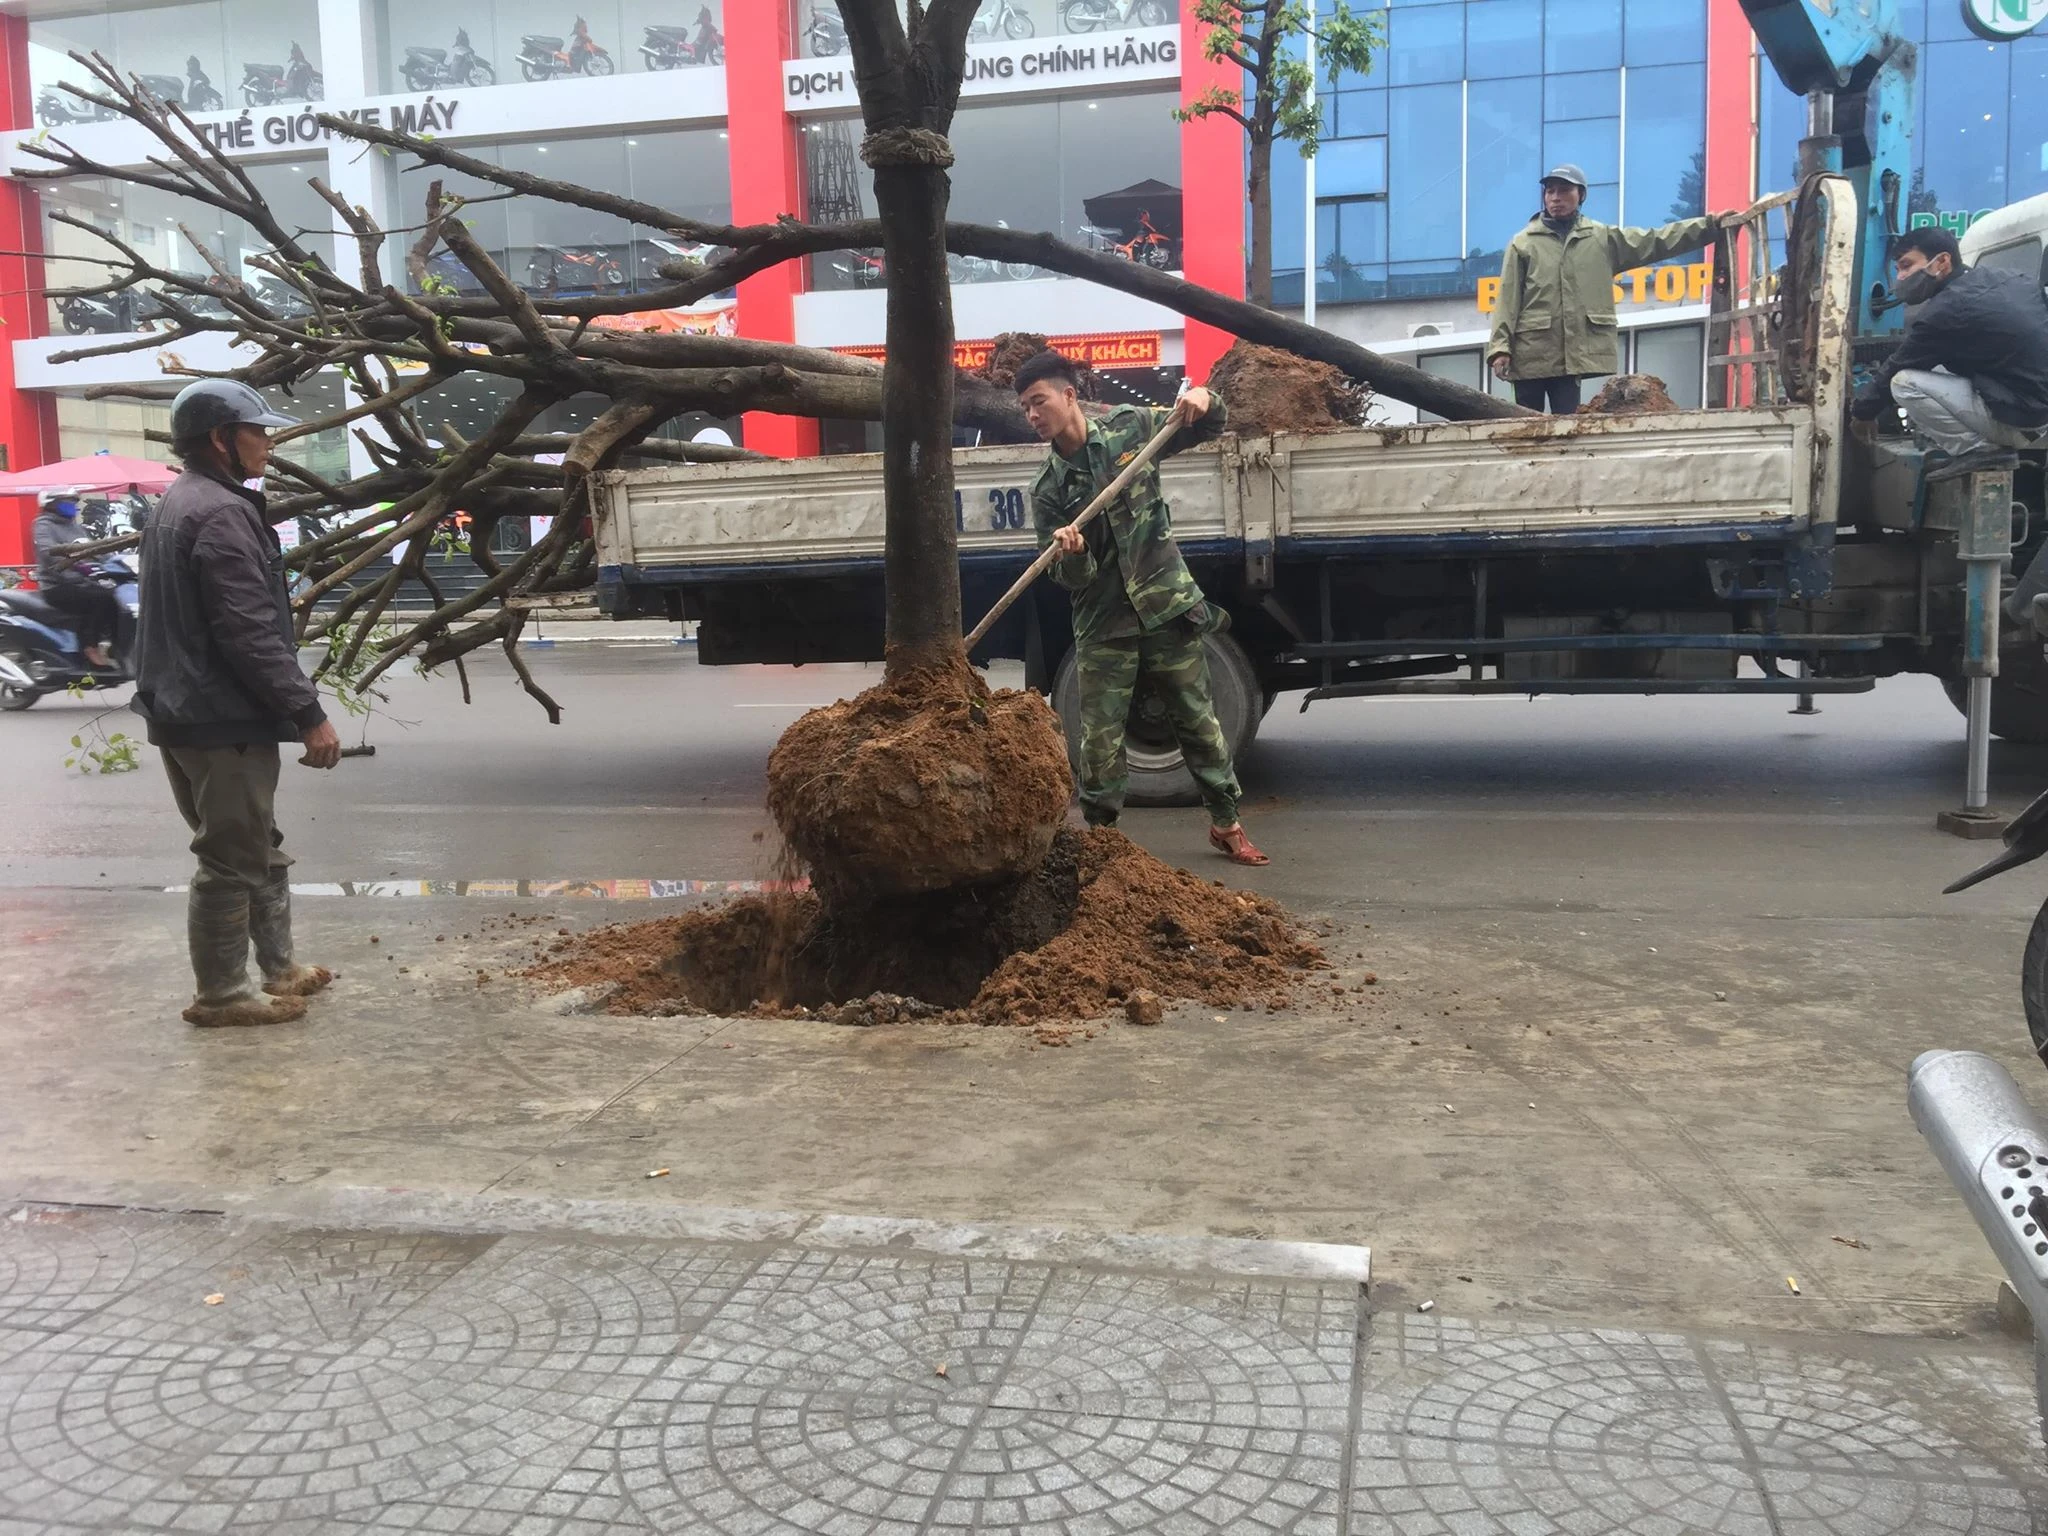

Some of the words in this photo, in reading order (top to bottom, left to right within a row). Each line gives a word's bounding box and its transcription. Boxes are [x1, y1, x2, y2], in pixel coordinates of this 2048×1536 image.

[788, 71, 843, 100] DỊCH
[963, 53, 1014, 81] ÙNG
[1021, 44, 1095, 76] CHÍNH
[1103, 36, 1177, 68] HÃNG
[391, 96, 458, 133] MÁY
[954, 348, 986, 367] HÀO
[1091, 340, 1153, 360] KHÁCH
